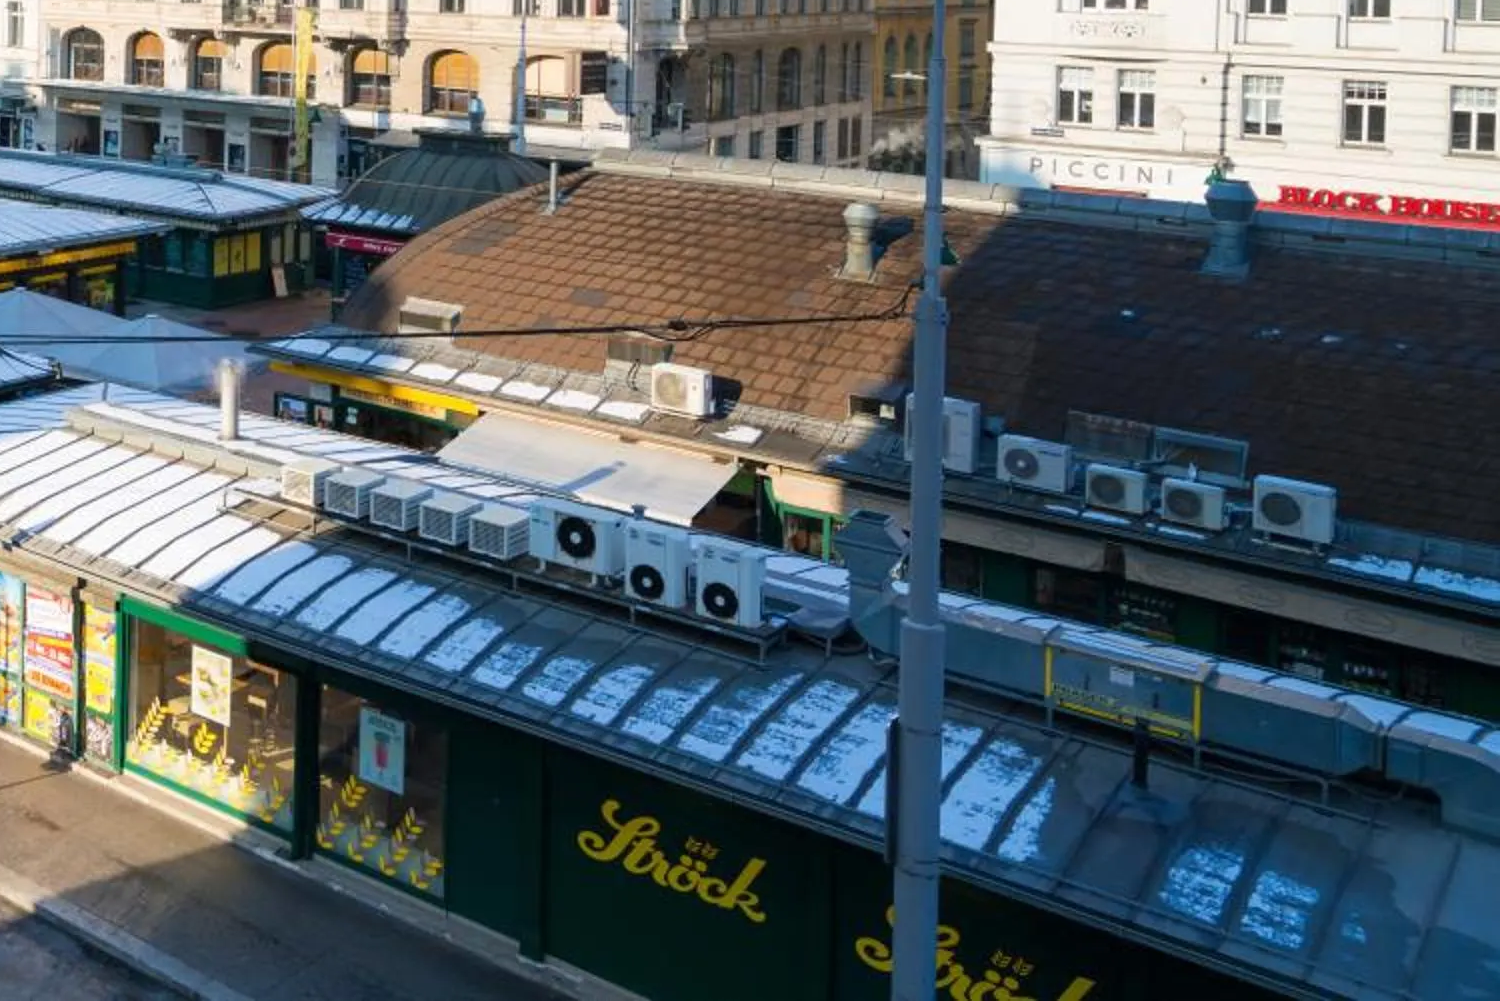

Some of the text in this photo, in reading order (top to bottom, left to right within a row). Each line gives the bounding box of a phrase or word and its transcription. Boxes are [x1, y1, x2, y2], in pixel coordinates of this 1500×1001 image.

[1029, 156, 1173, 185] PICCINI
[1278, 185, 1500, 225] BLOCK HOUSE
[576, 797, 768, 925] Ströck
